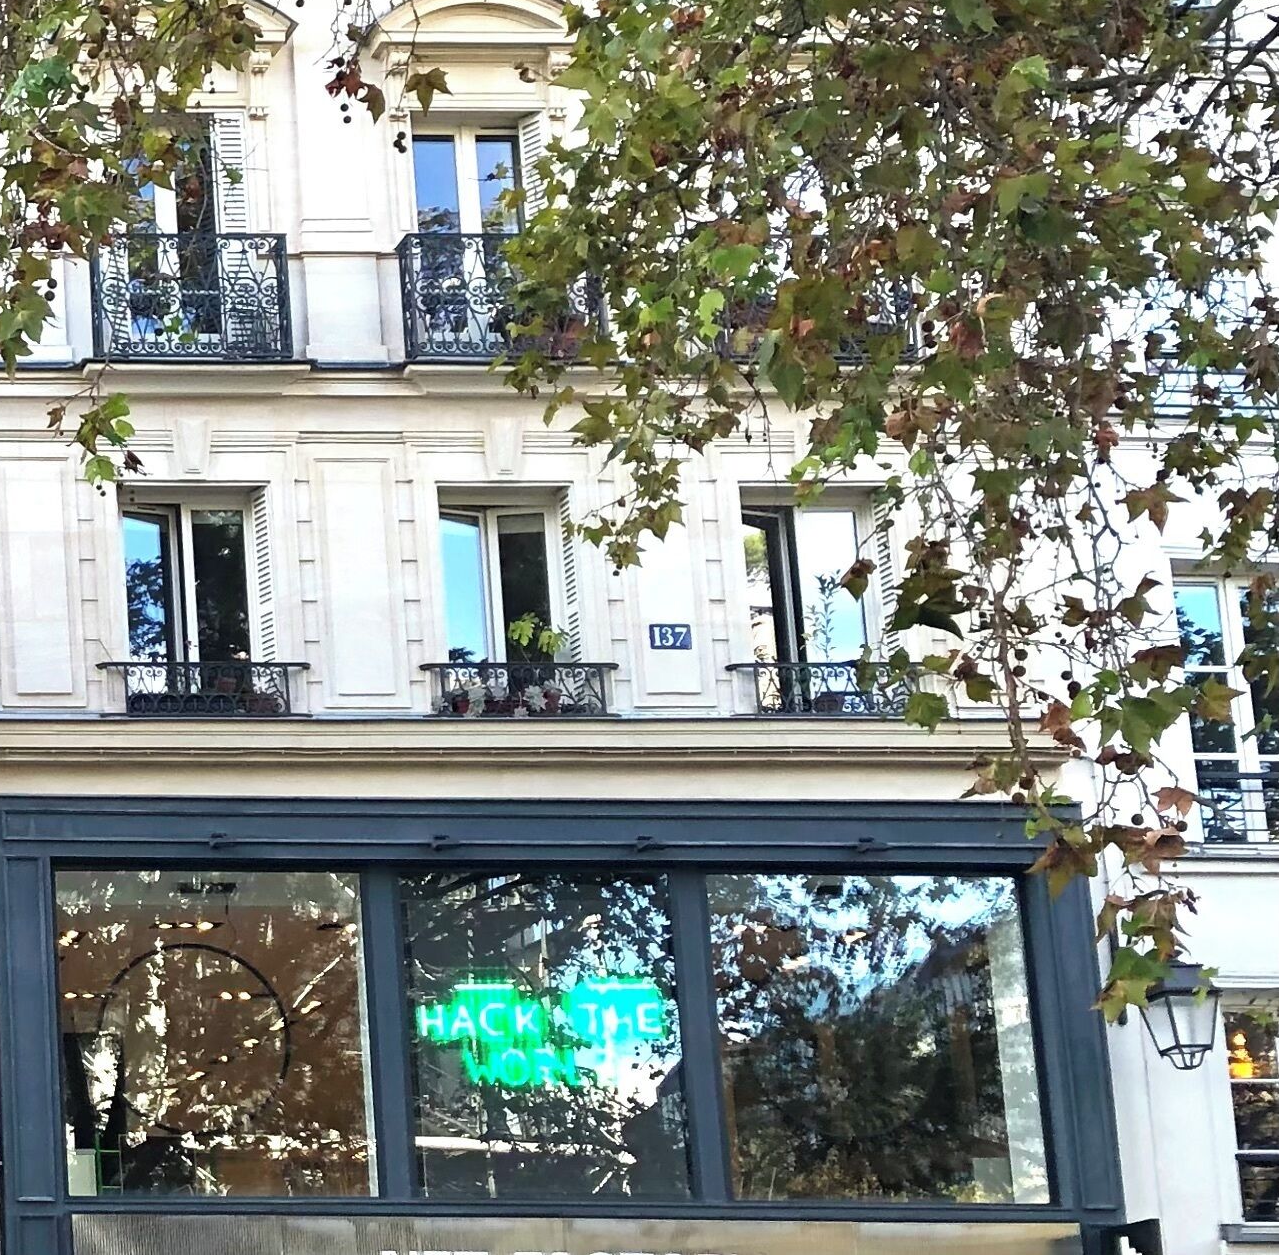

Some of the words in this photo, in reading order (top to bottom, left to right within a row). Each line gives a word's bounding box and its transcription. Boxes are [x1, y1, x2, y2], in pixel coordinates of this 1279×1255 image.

[653, 626, 688, 647] 137
[419, 1003, 541, 1037] HACK
[577, 1003, 663, 1034] THE
